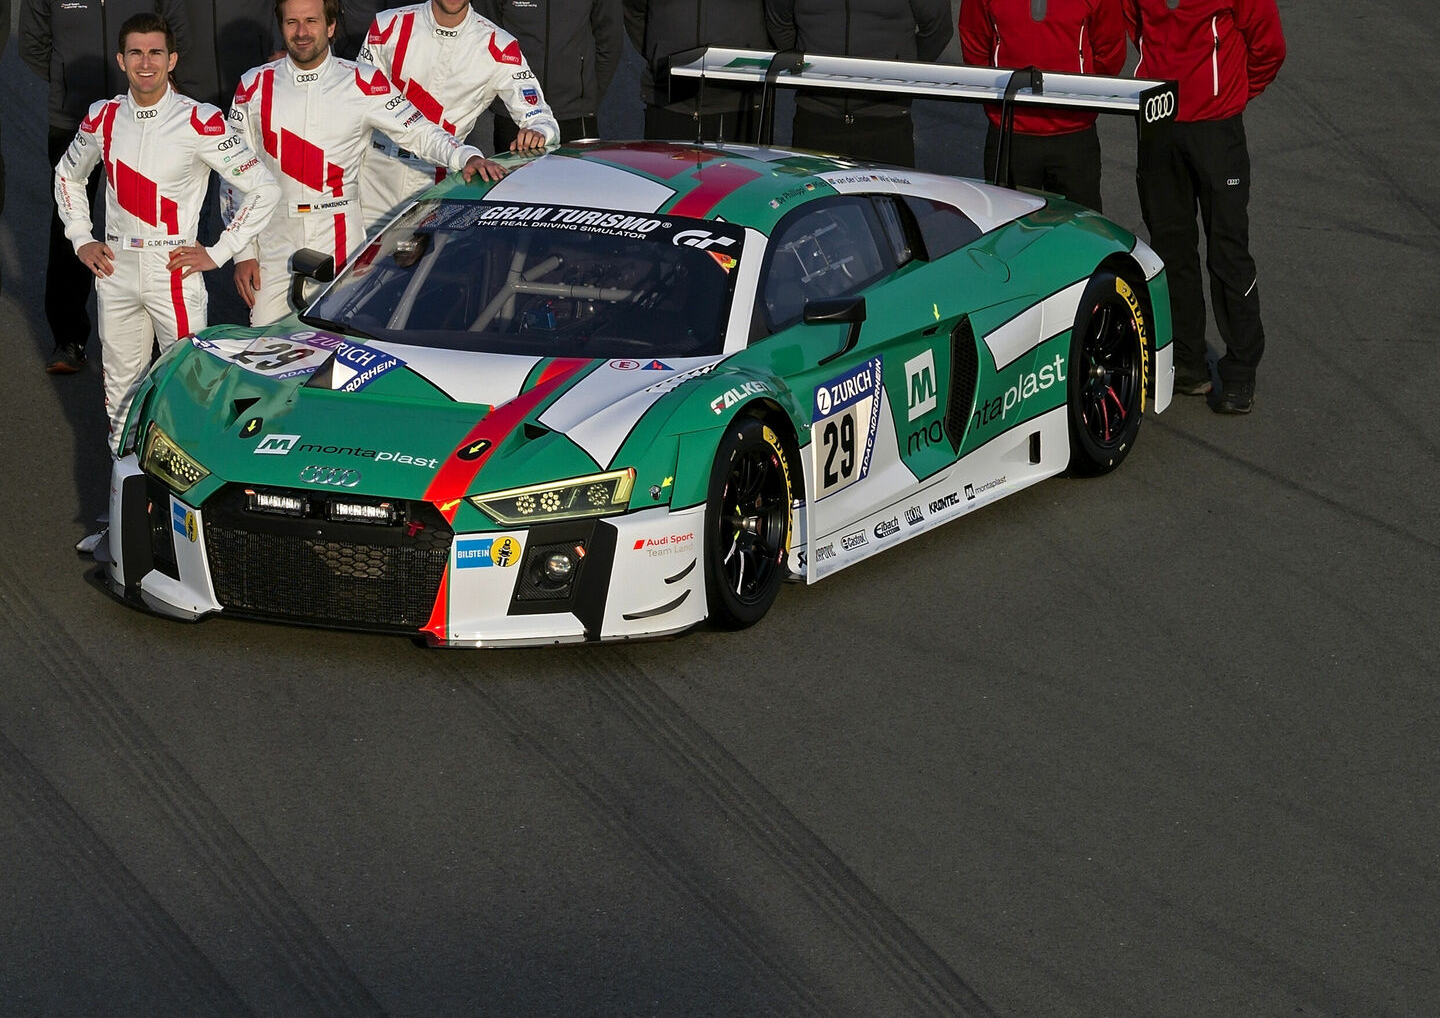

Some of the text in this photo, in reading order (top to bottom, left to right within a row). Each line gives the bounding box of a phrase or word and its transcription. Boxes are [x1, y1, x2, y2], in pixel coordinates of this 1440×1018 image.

[480, 205, 547, 222] GRAN
[500, 220, 529, 228] REAL
[531, 221, 578, 230] DRIVING
[579, 225, 647, 241] SIMULATOR
[229, 341, 315, 371] 29
[278, 367, 316, 380] ADAC
[831, 369, 873, 407] ZURICH
[861, 357, 882, 477] ADAC NORDRHEIN
[299, 443, 439, 469] montaplast
[823, 413, 855, 489] 29
[975, 476, 1007, 495] montaplast
[646, 533, 694, 547] Audi Sport
[458, 549, 489, 559] BILSTEIN
[647, 543, 694, 558] Team Land
